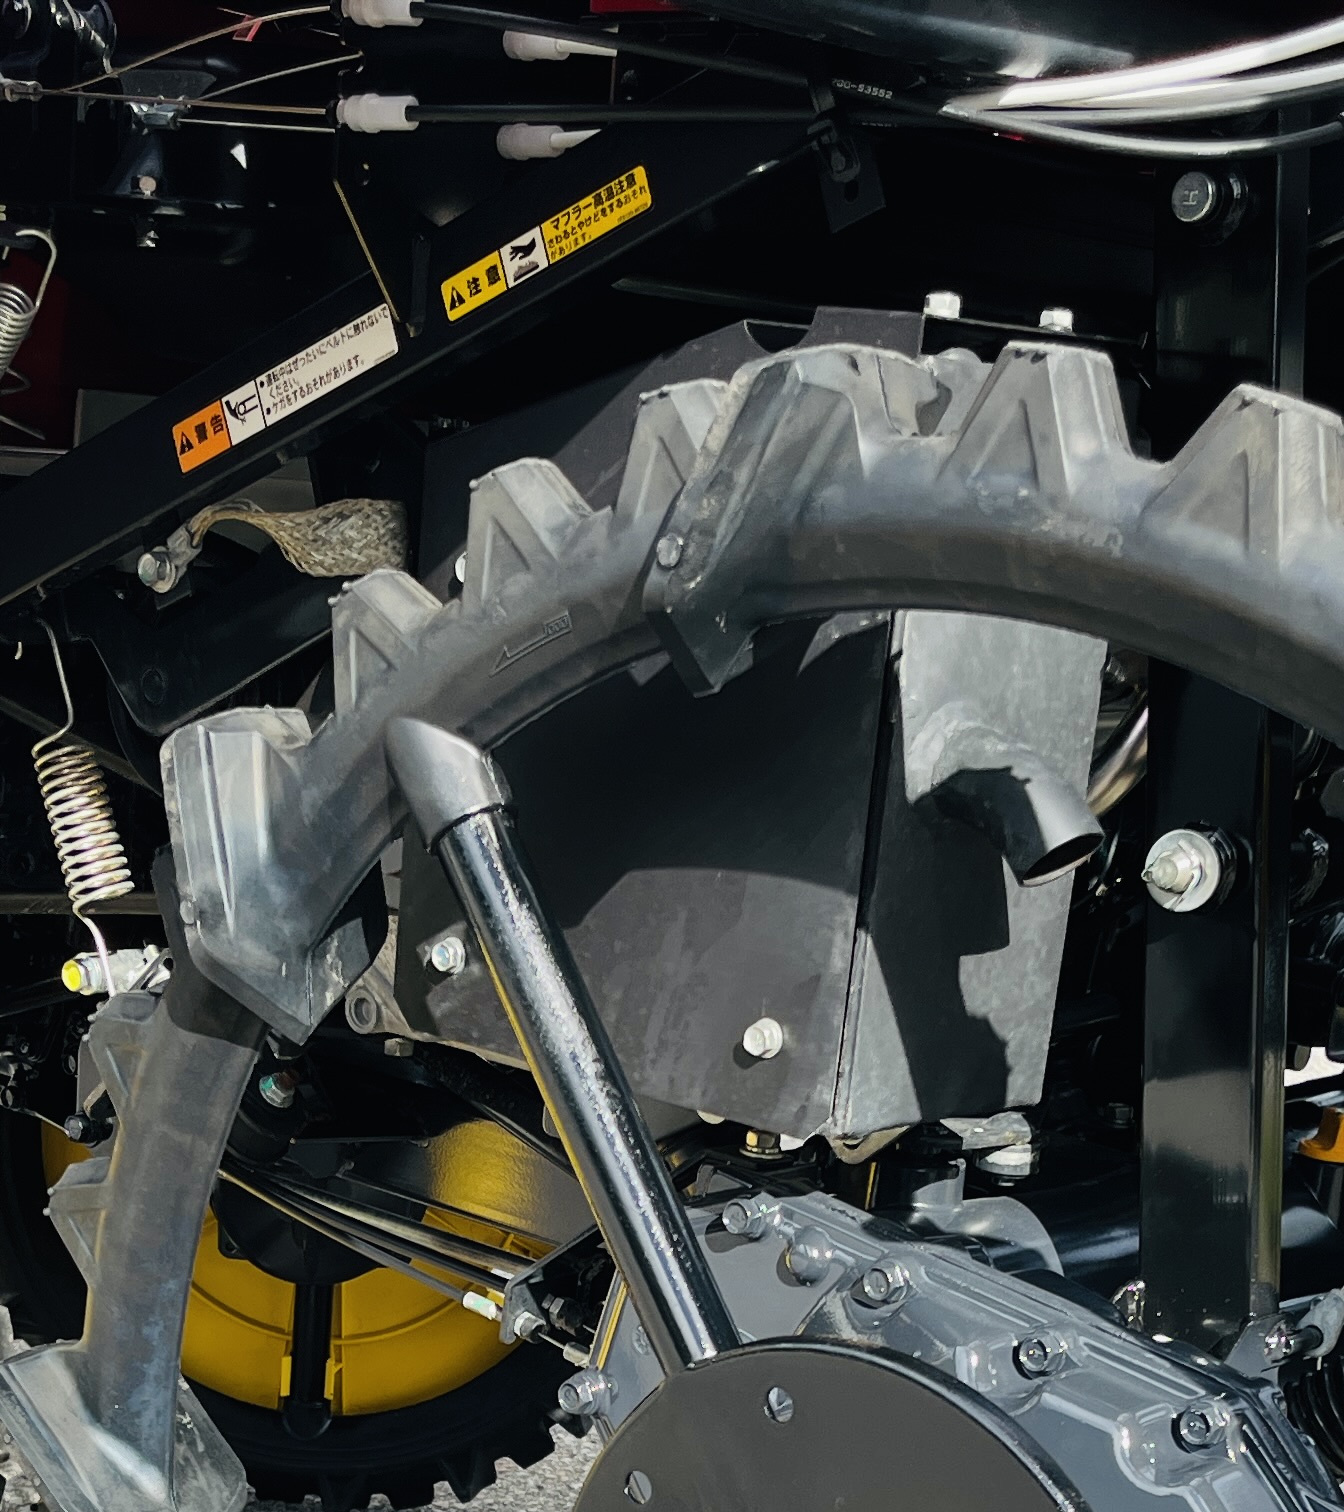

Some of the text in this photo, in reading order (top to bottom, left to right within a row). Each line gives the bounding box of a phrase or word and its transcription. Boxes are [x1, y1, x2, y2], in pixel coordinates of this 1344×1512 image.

[550, 172, 636, 230] マフラー高温注意
[467, 264, 501, 297] 注意
